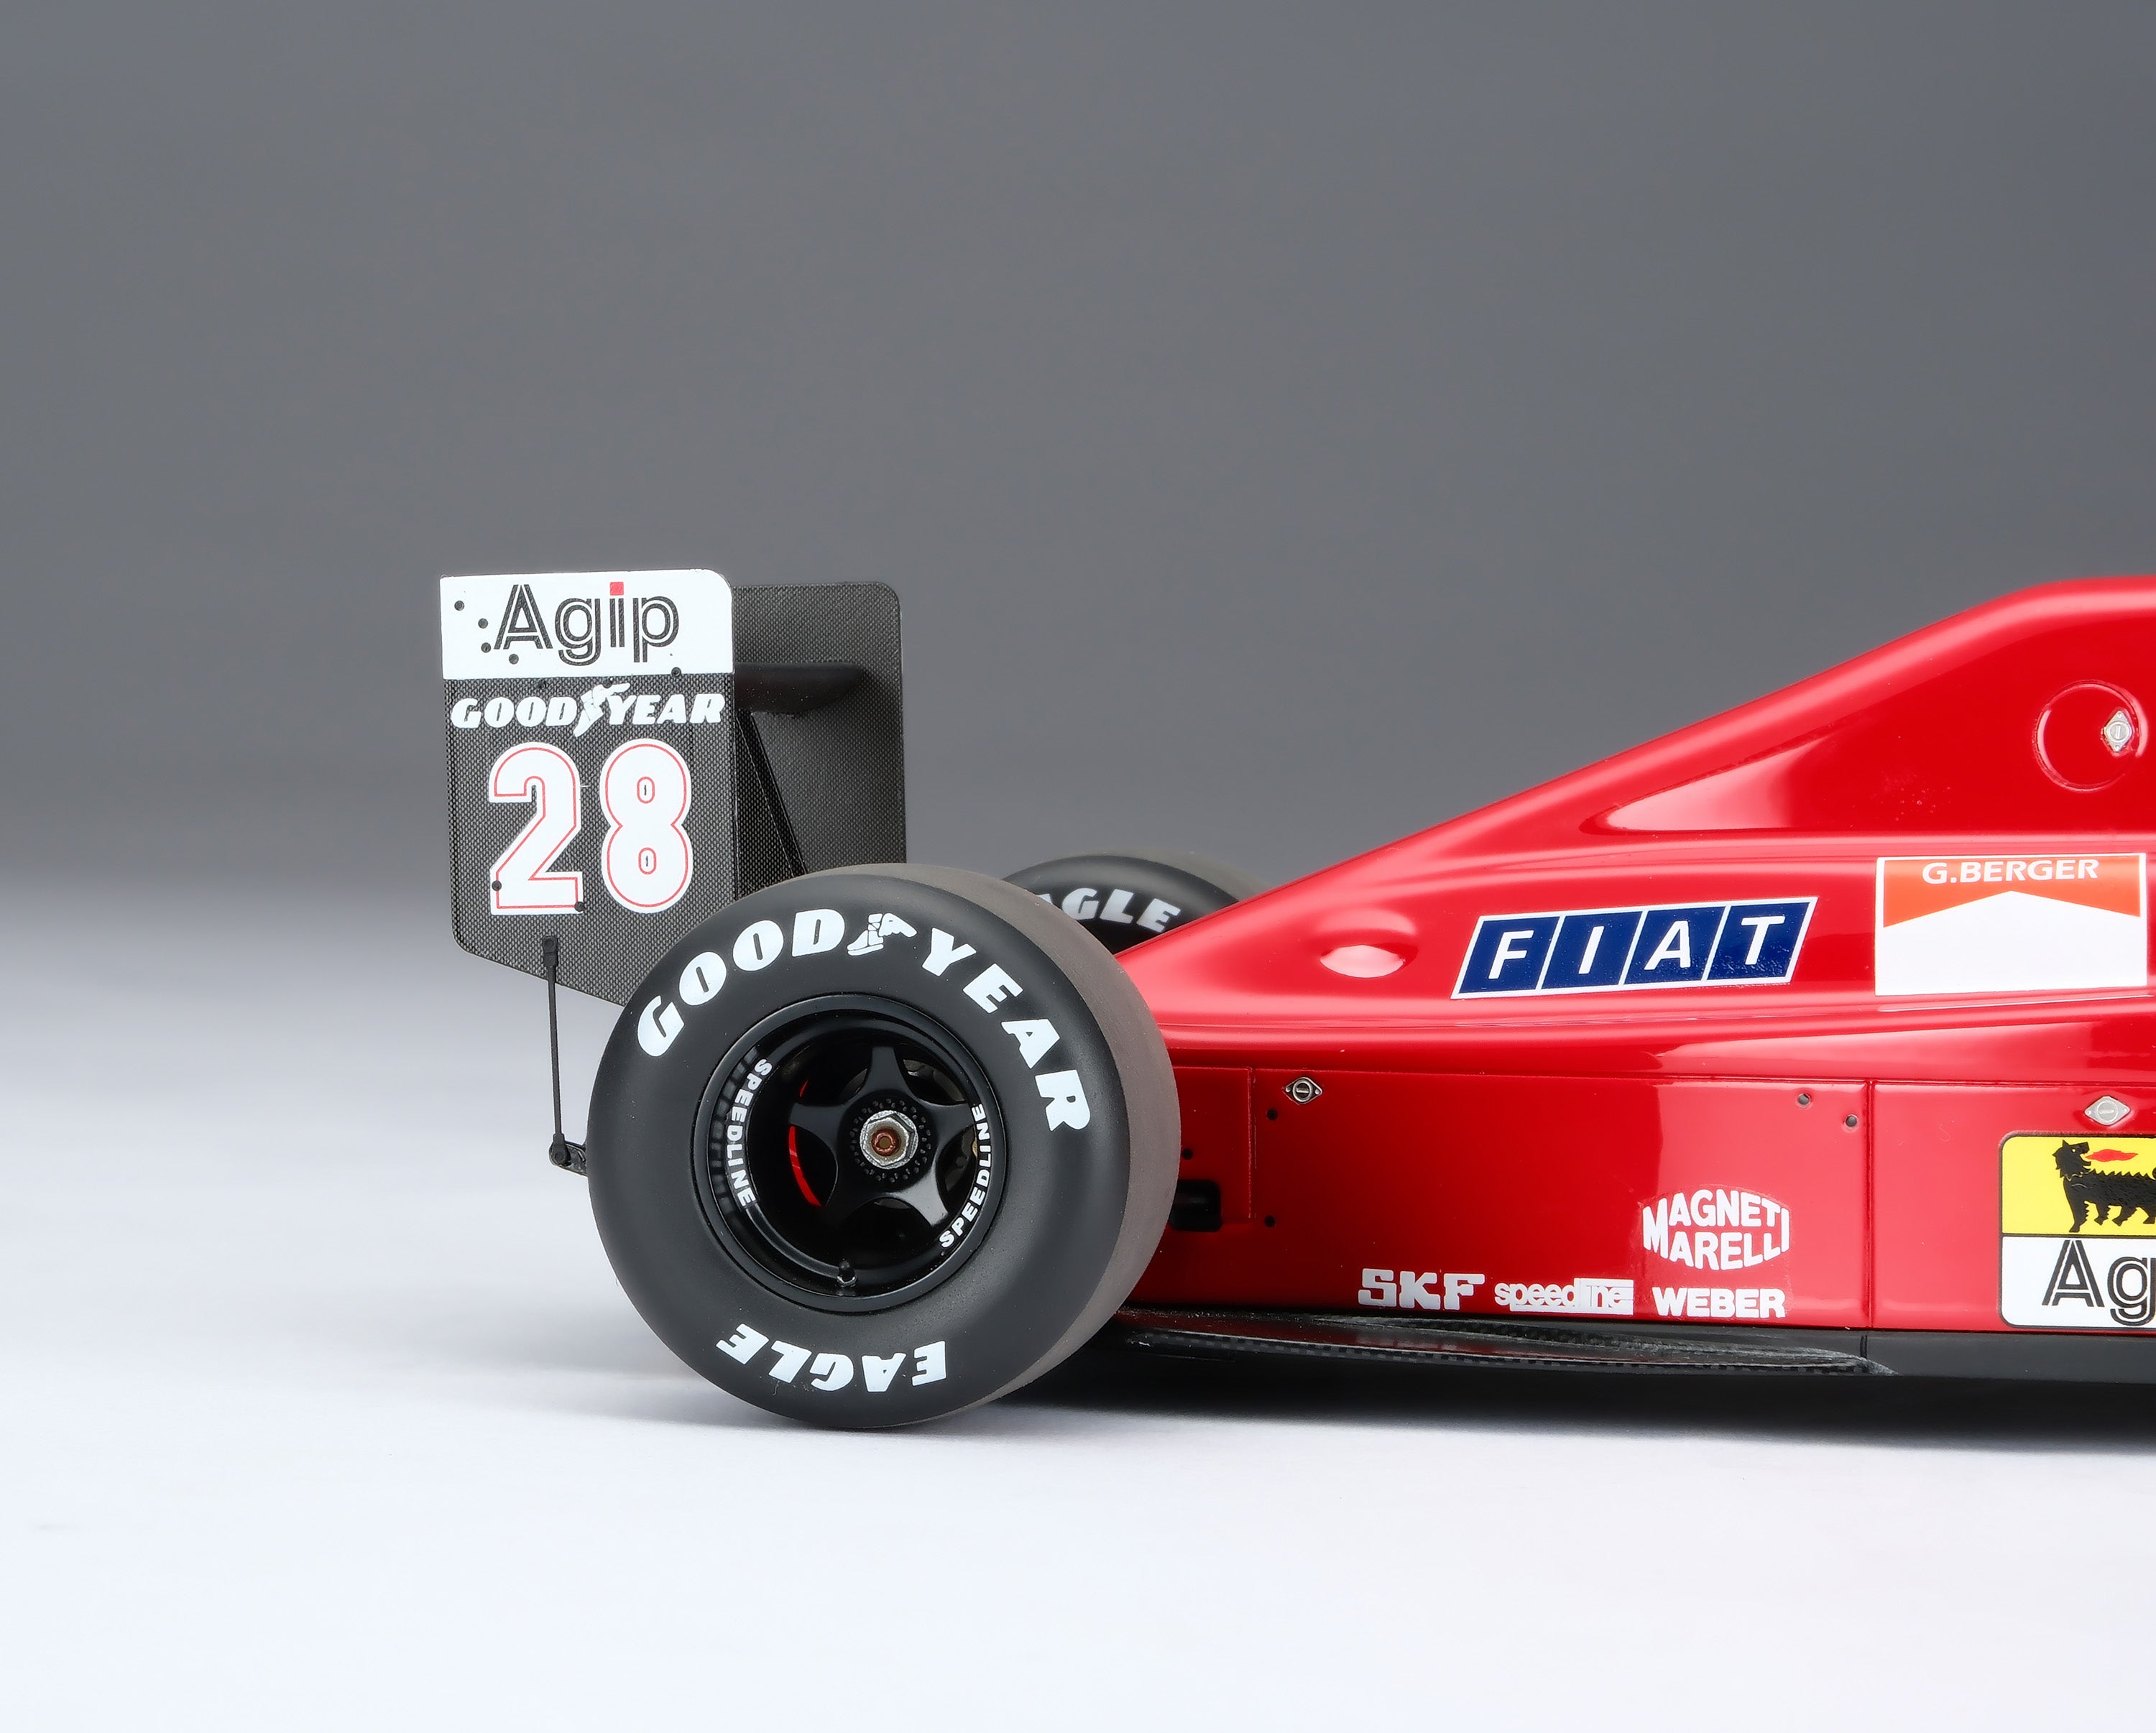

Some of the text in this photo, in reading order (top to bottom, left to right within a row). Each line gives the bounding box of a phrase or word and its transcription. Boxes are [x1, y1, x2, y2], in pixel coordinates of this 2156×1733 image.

[494, 581, 679, 665] Agip
[489, 739, 693, 915] 28
[1922, 859, 2099, 884] G.BERGER
[1487, 915, 1785, 980] FIAT
[727, 1058, 773, 1207] SPEEDLINE
[939, 1104, 992, 1248] SPEEDLINE
[1642, 1189, 1789, 1243] MAGNETI
[1642, 1214, 1789, 1270] MARELLI
[1358, 1268, 1485, 1311] SKF
[1651, 1287, 1786, 1318] WEBER
[717, 1324, 947, 1393] EAGLE
